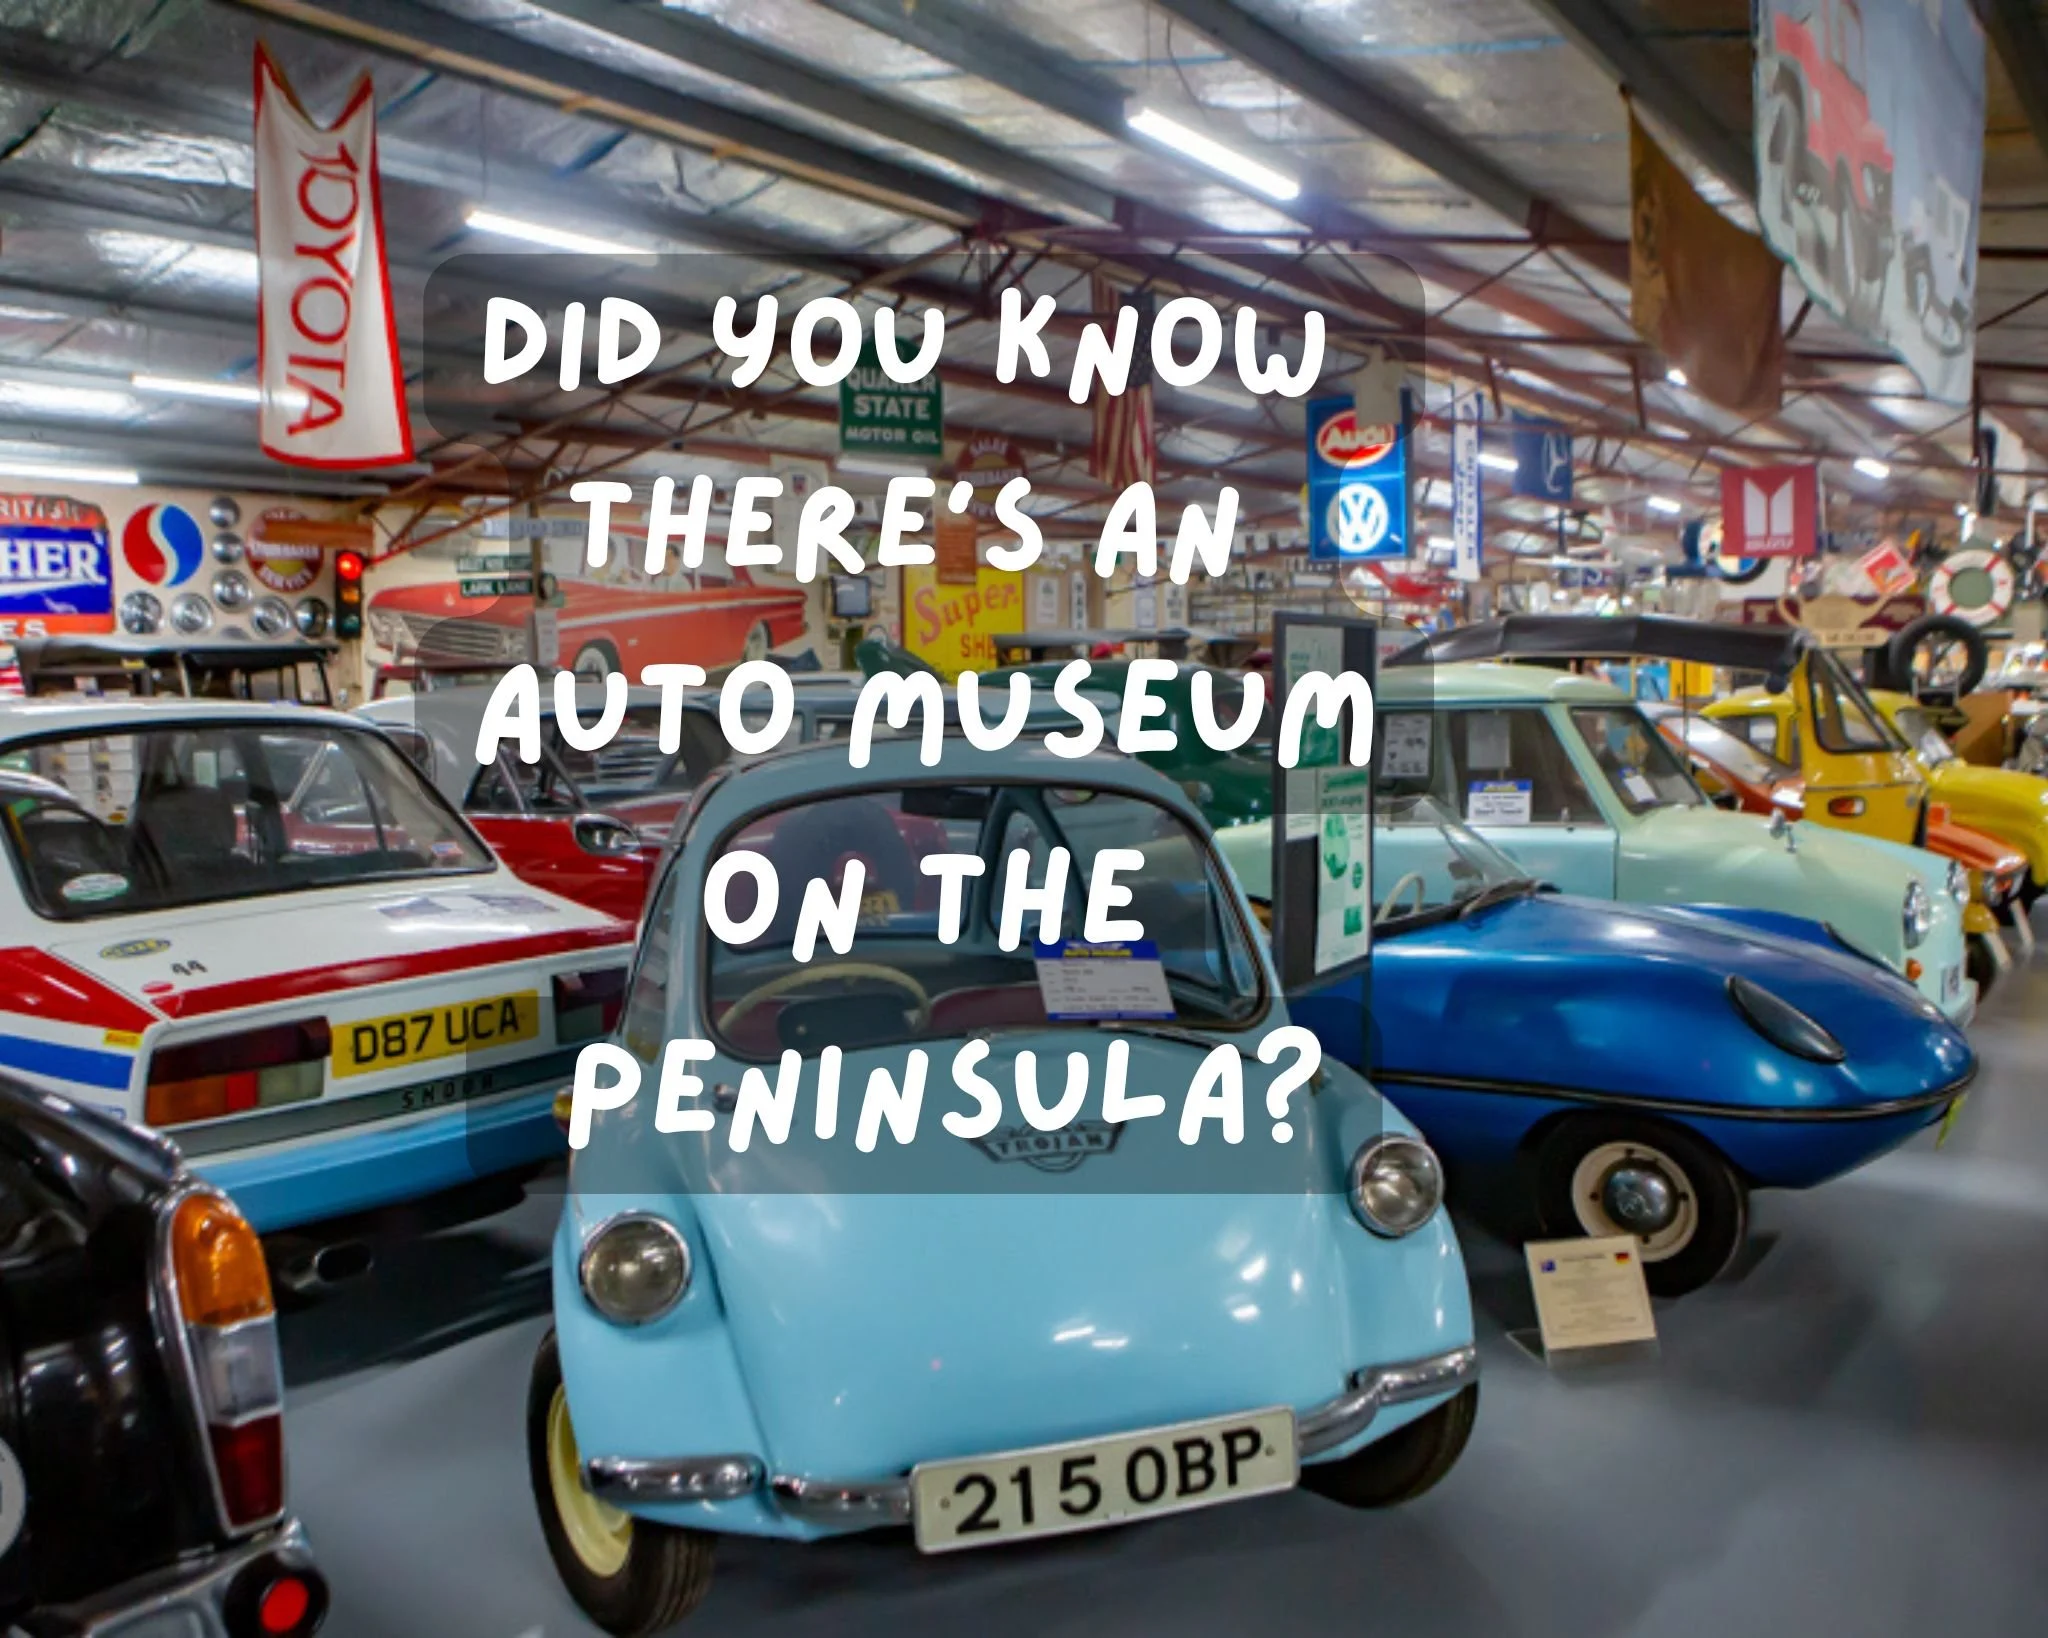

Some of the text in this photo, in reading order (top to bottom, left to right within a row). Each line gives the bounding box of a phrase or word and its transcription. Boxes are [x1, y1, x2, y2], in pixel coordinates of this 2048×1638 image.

[286, 141, 363, 437] TOYOTA
[853, 395, 931, 421] STATE
[844, 425, 940, 445] MOTOR OIL
[352, 997, 519, 1065] D87 UCA
[996, 1132, 1103, 1155] TROJAN
[953, 1455, 1102, 1535] 215
